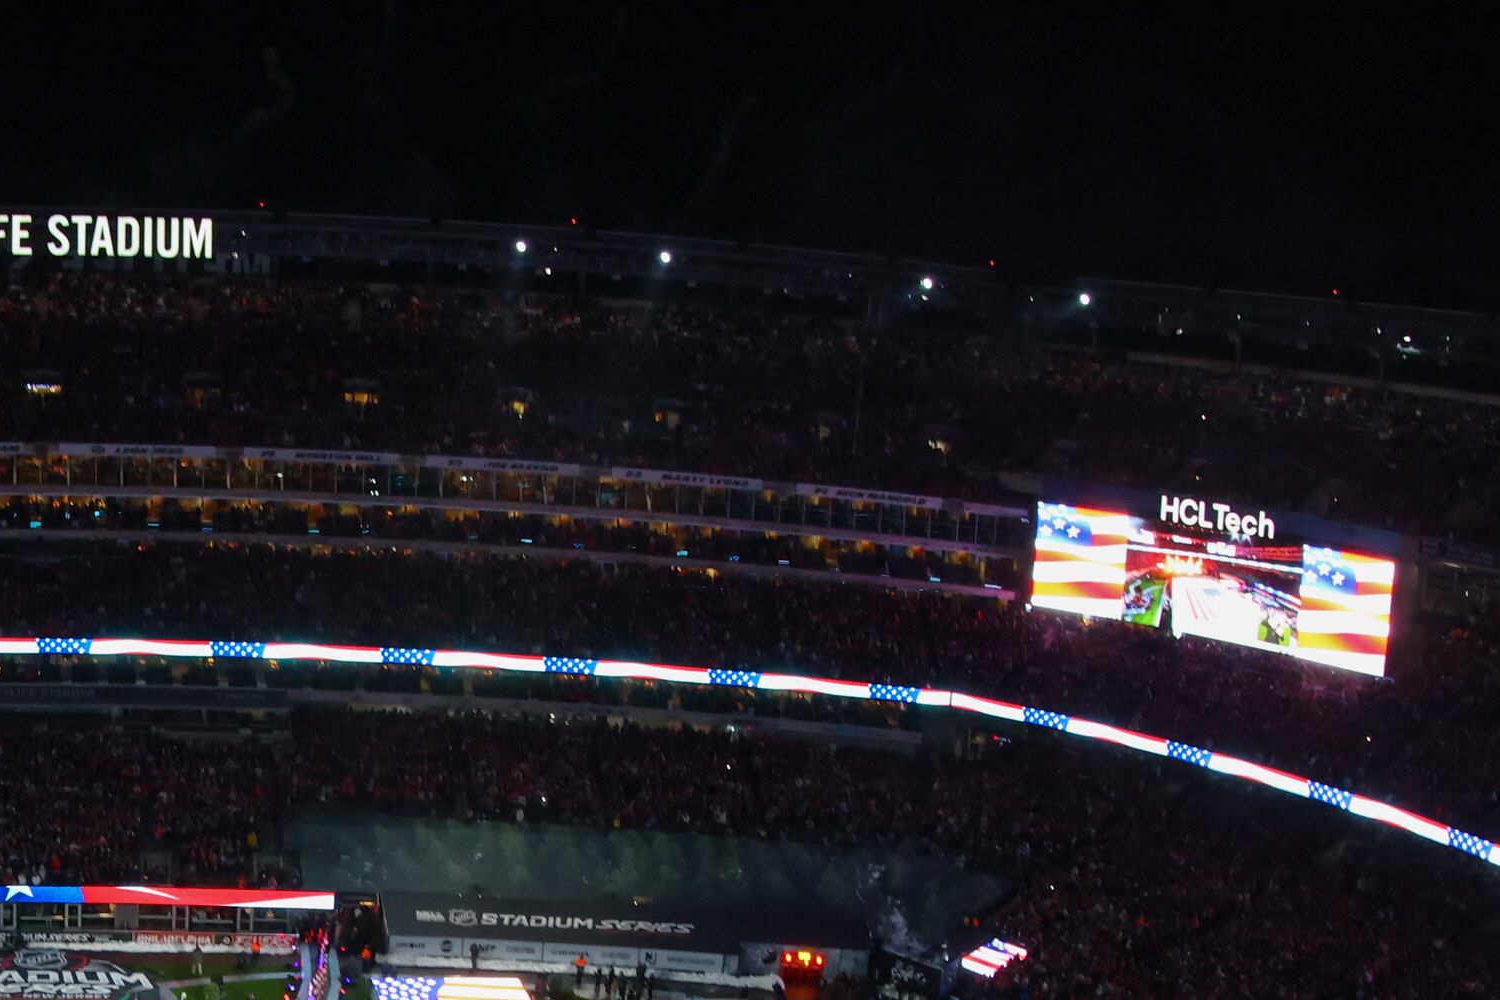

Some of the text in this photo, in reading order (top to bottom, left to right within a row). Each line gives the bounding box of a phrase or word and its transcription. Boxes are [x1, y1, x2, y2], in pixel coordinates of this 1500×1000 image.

[47, 214, 214, 259] STADIUM
[1159, 494, 1275, 540] HCLTech
[481, 912, 594, 930] STADIUM
[595, 919, 695, 935] SERIES
